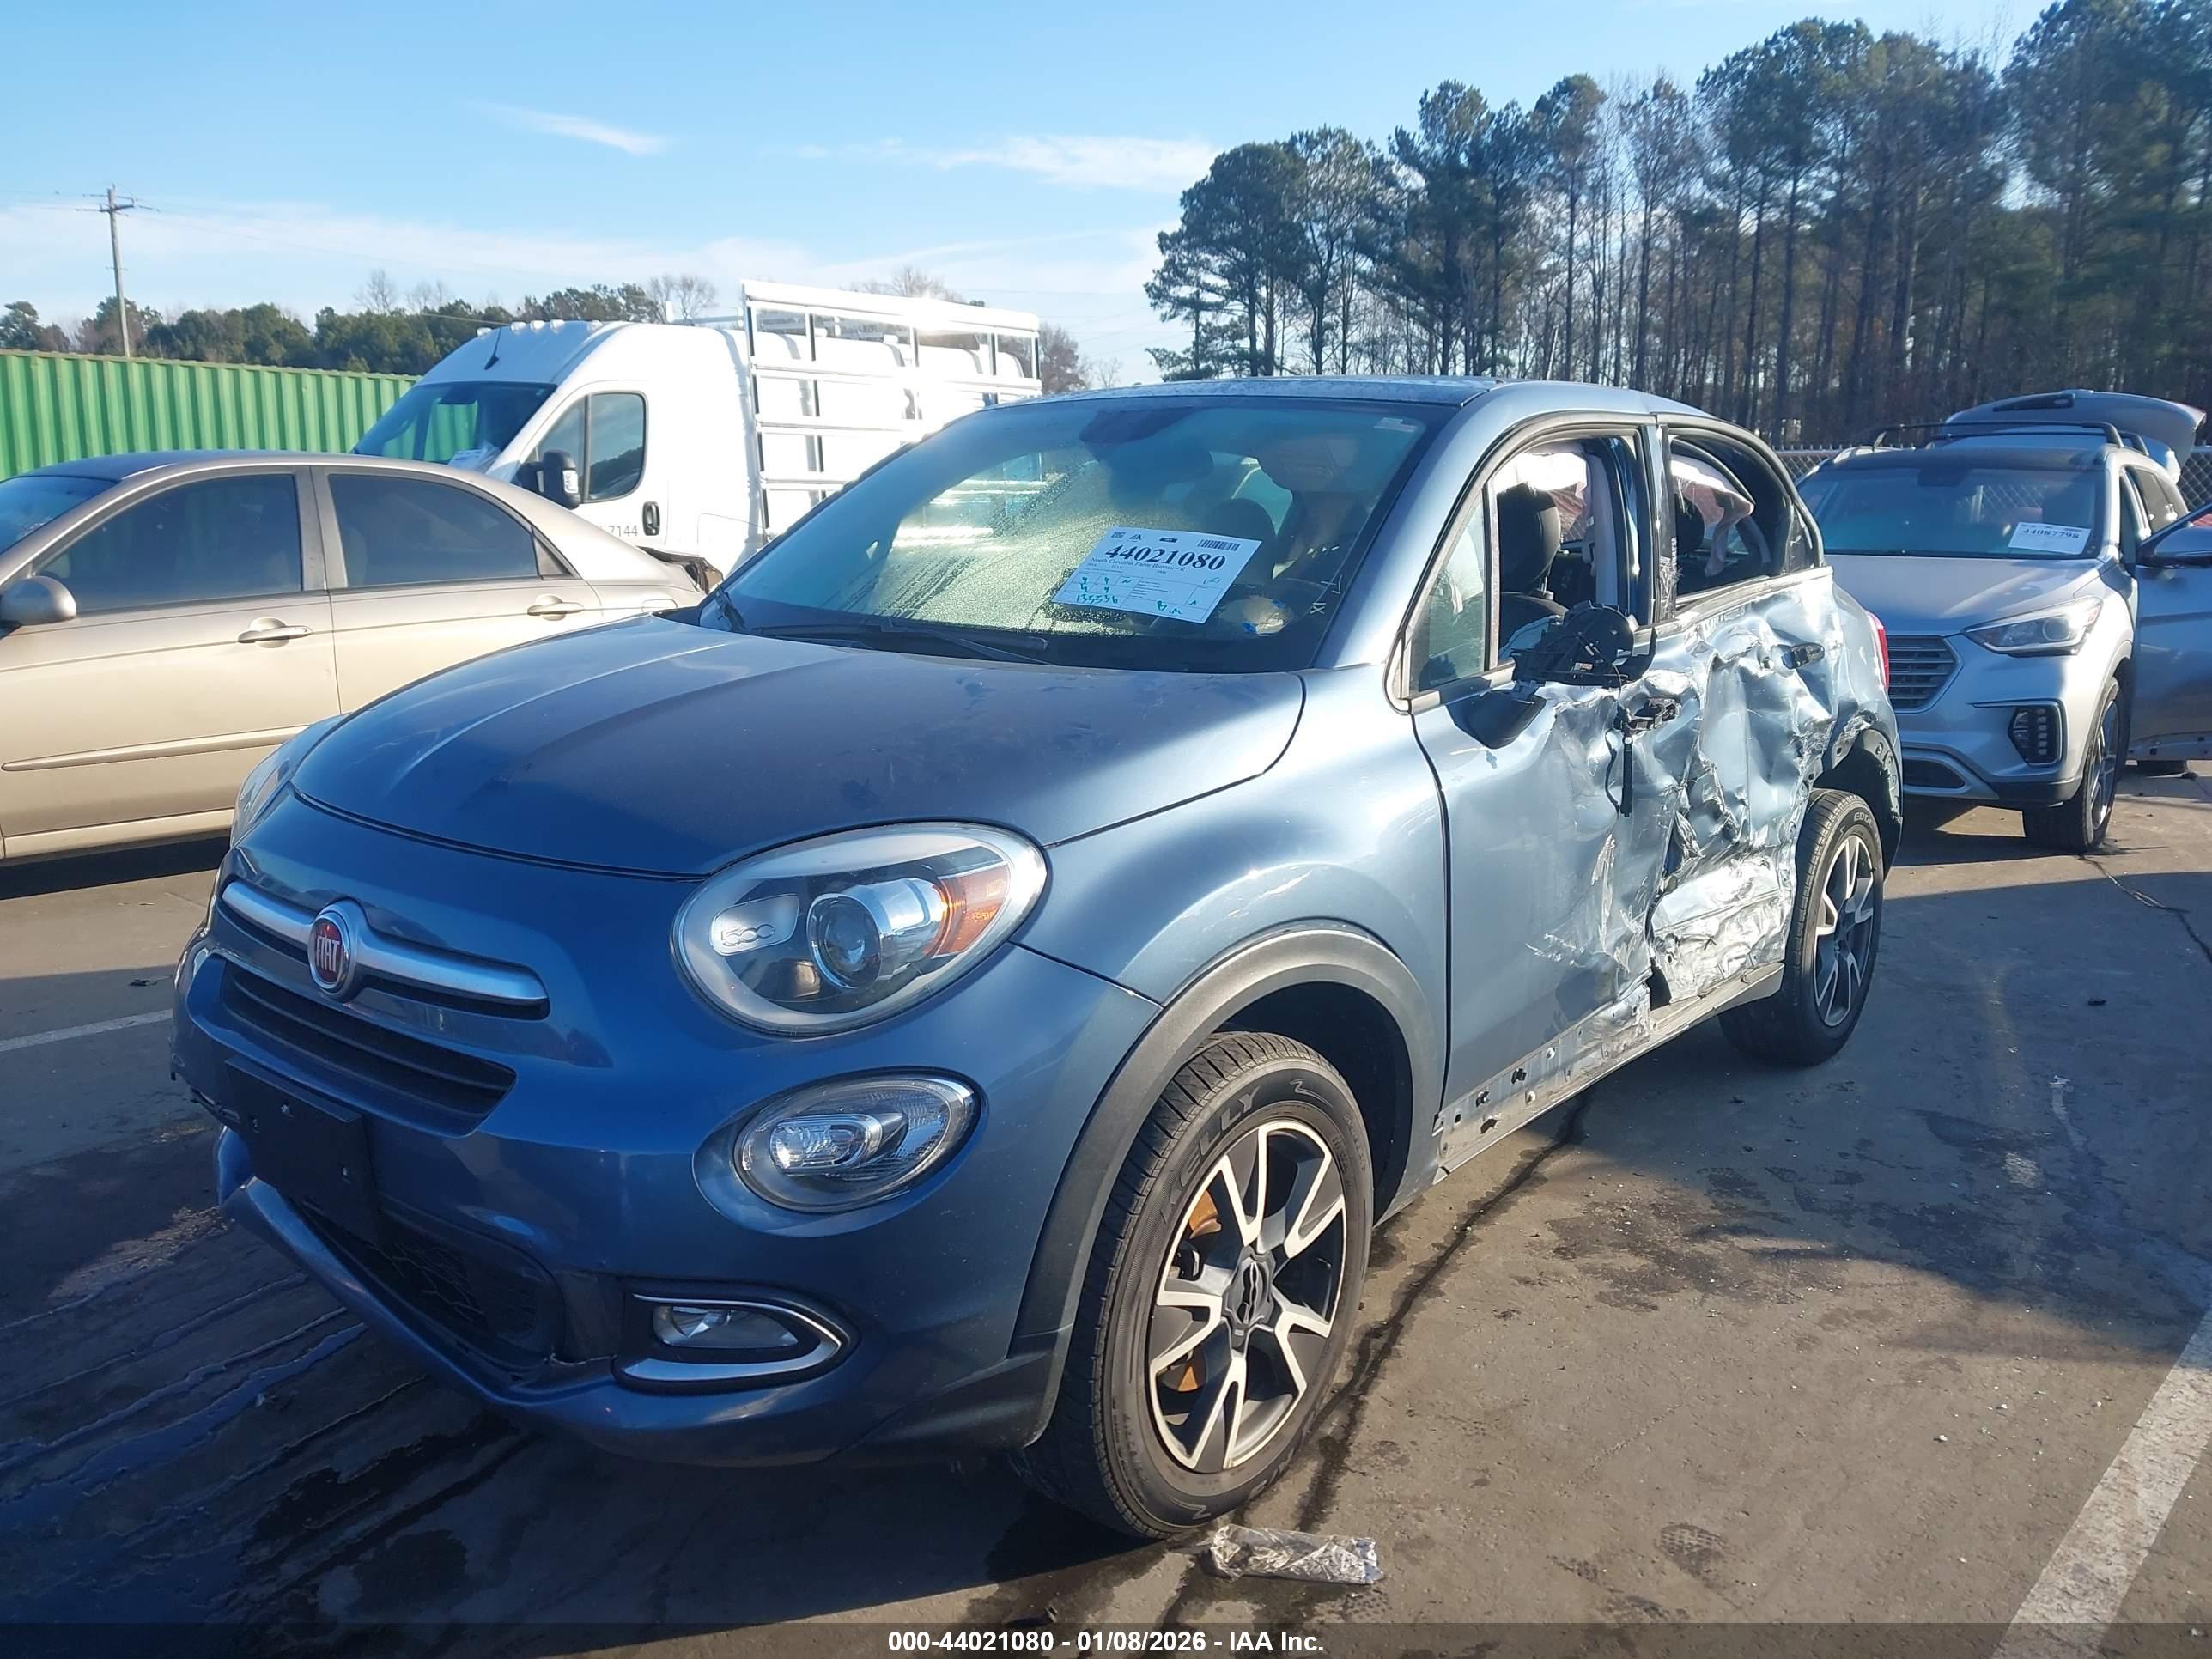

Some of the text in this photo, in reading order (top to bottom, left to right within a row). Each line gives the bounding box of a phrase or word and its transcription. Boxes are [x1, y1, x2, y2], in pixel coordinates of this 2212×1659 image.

[608, 525, 639, 537] 7144
[1105, 544, 1226, 571] 44021080
[720, 923, 776, 947] 500
[316, 934, 341, 972] FIAT
[1159, 1085, 1261, 1225] KELLY
